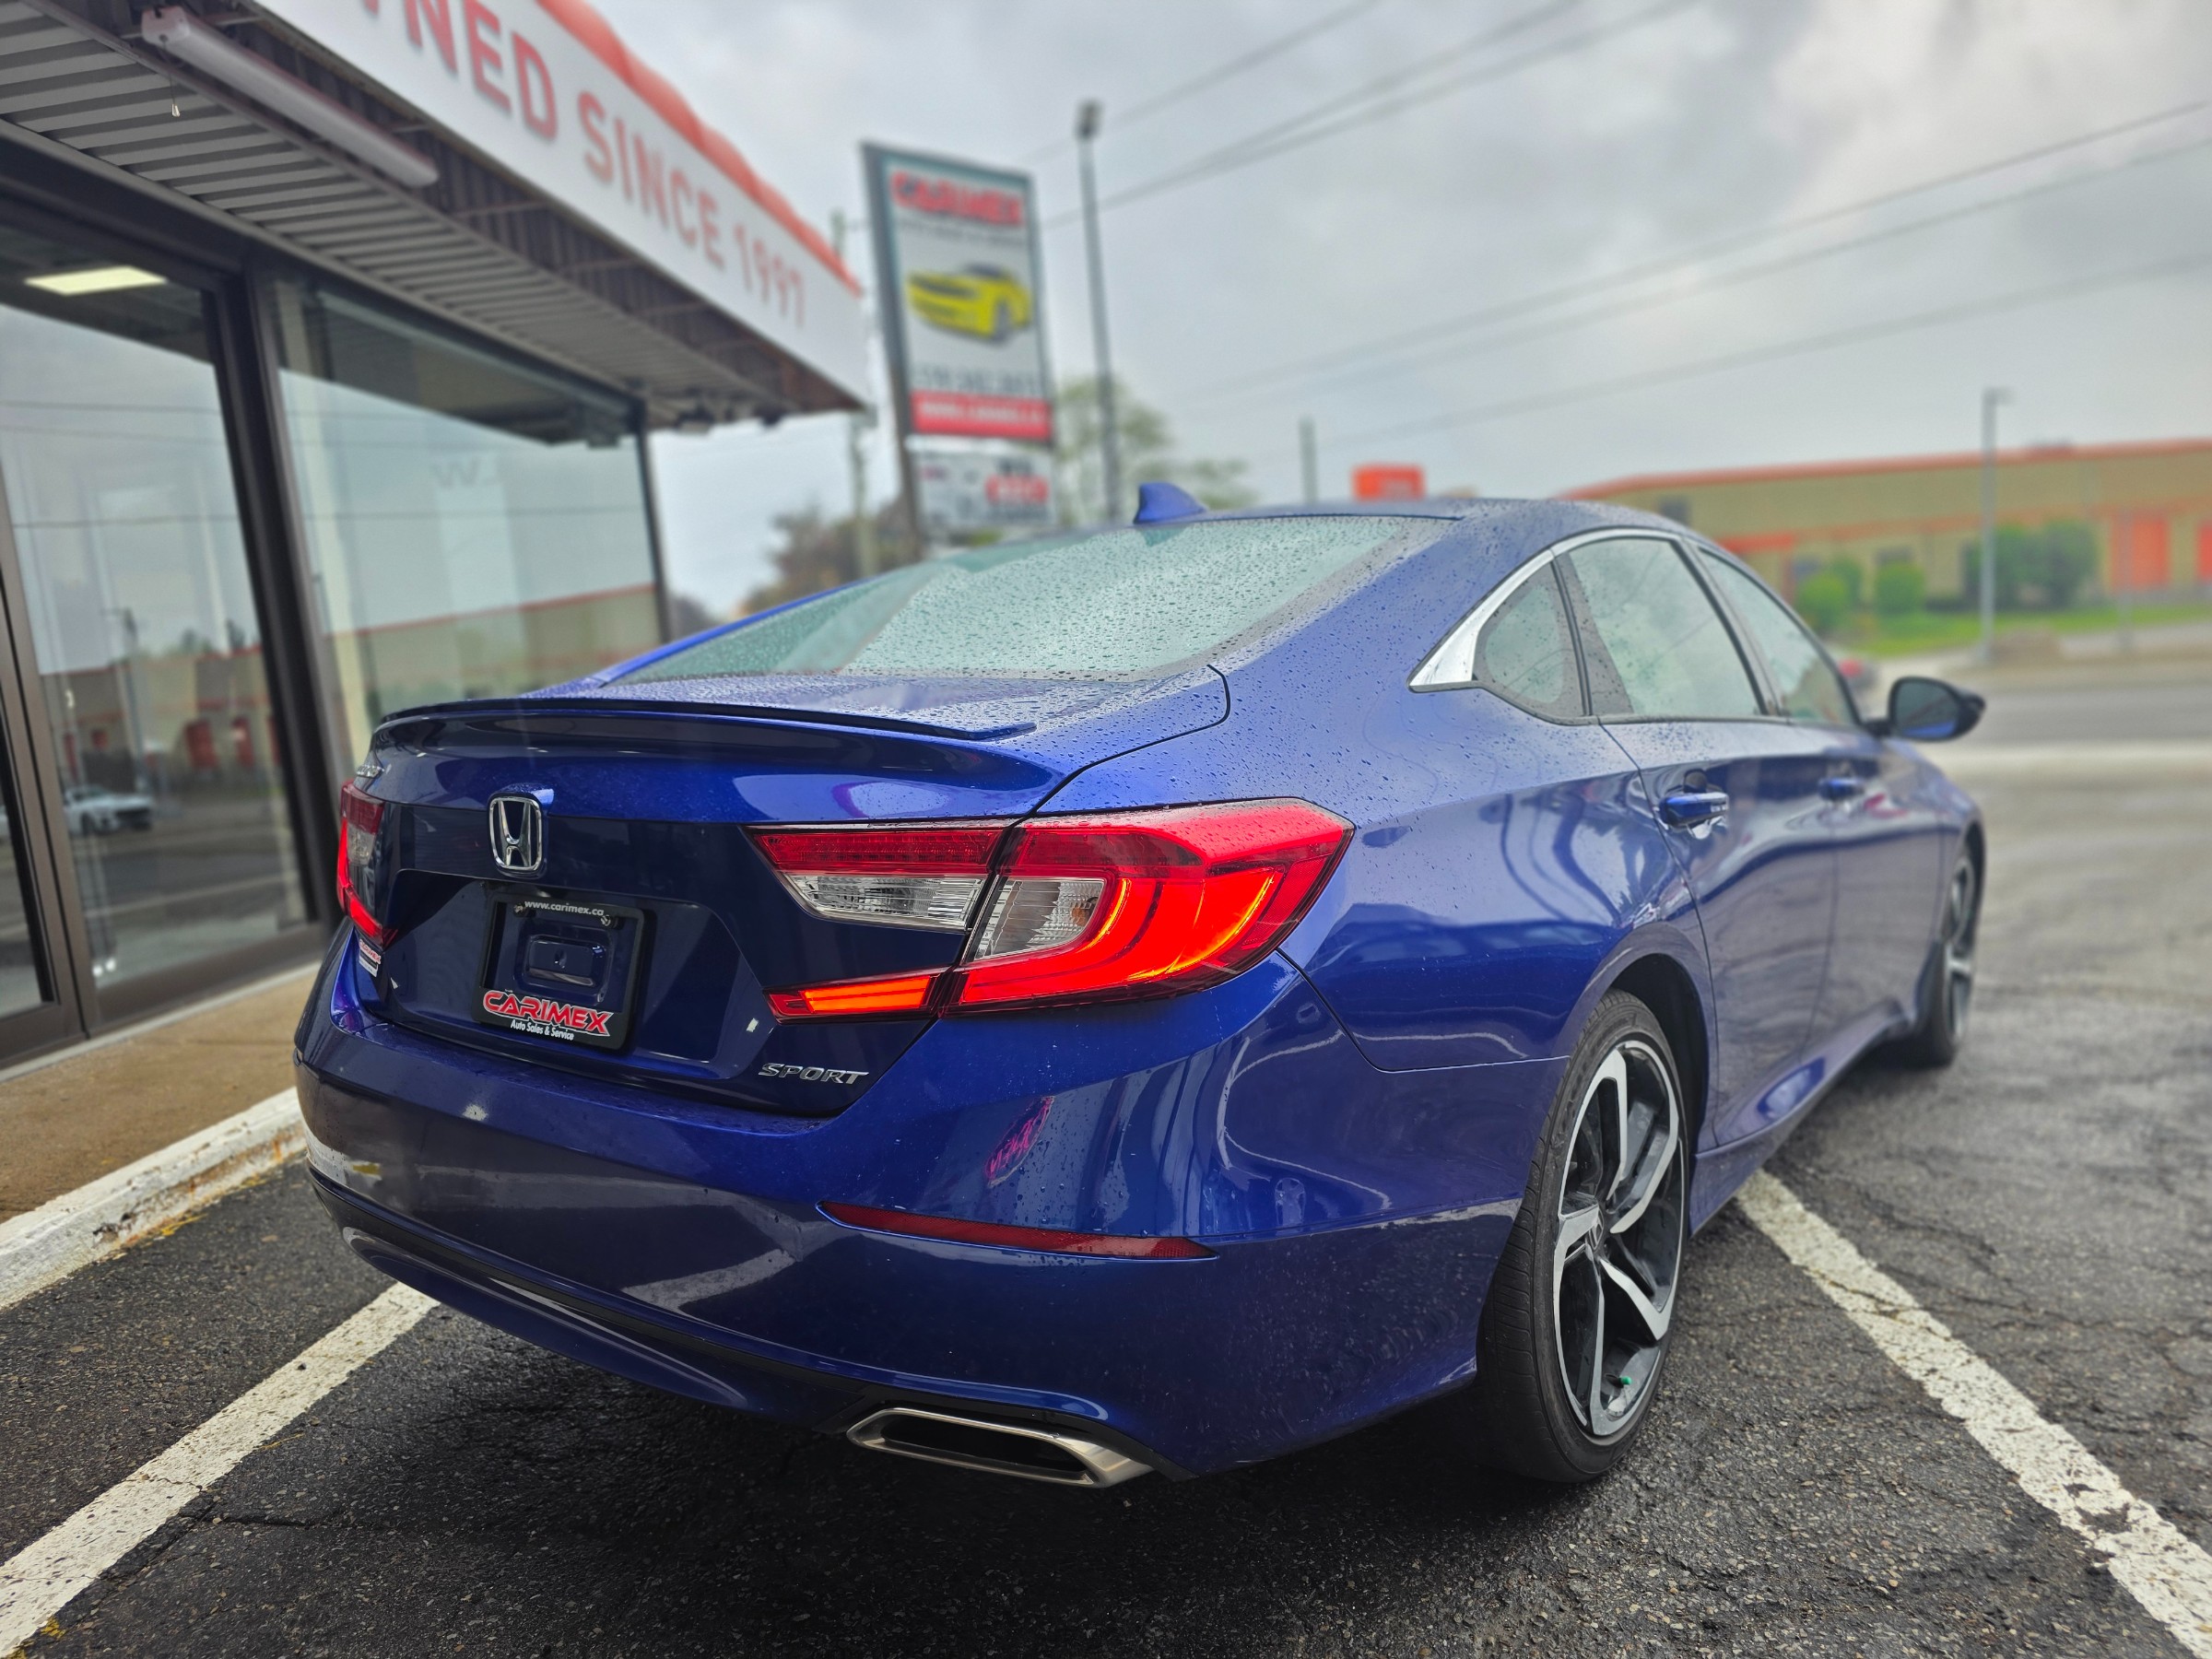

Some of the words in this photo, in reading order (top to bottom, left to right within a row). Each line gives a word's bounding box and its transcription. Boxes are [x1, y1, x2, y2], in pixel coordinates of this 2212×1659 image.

[361, 0, 558, 140] NED
[578, 89, 725, 273] SINCE
[524, 900, 605, 916] www.carimex.ca
[482, 990, 614, 1037] CARIMEX
[510, 1018, 526, 1031] Auto
[526, 1022, 544, 1034] Sales
[544, 1026, 550, 1036] &
[550, 1027, 575, 1041] Service
[758, 1062, 870, 1085] SPORT
